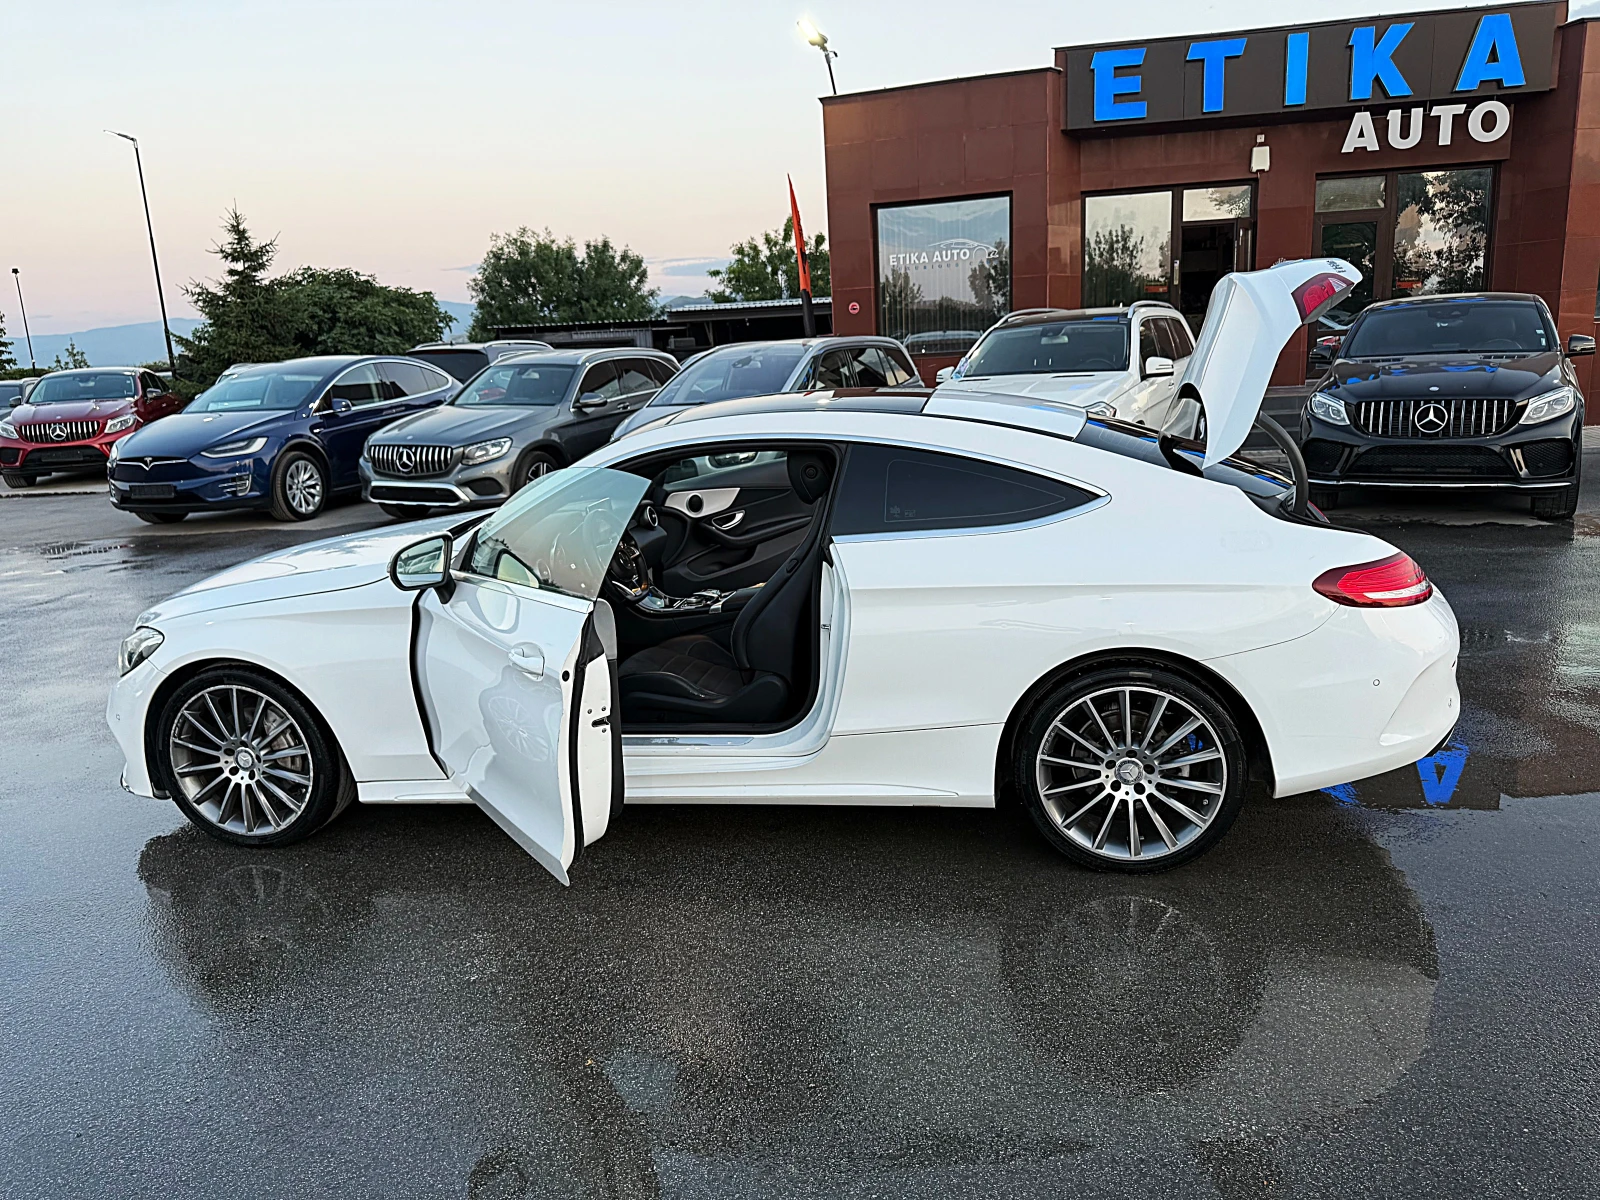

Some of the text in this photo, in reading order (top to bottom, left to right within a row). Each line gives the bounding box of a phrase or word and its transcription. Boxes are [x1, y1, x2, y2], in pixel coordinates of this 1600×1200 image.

[1090, 13, 1526, 121] ETIKA
[1341, 100, 1511, 153] AUTO
[889, 249, 970, 265] ETIKA AUTO
[892, 263, 959, 272] UXURIOUS
